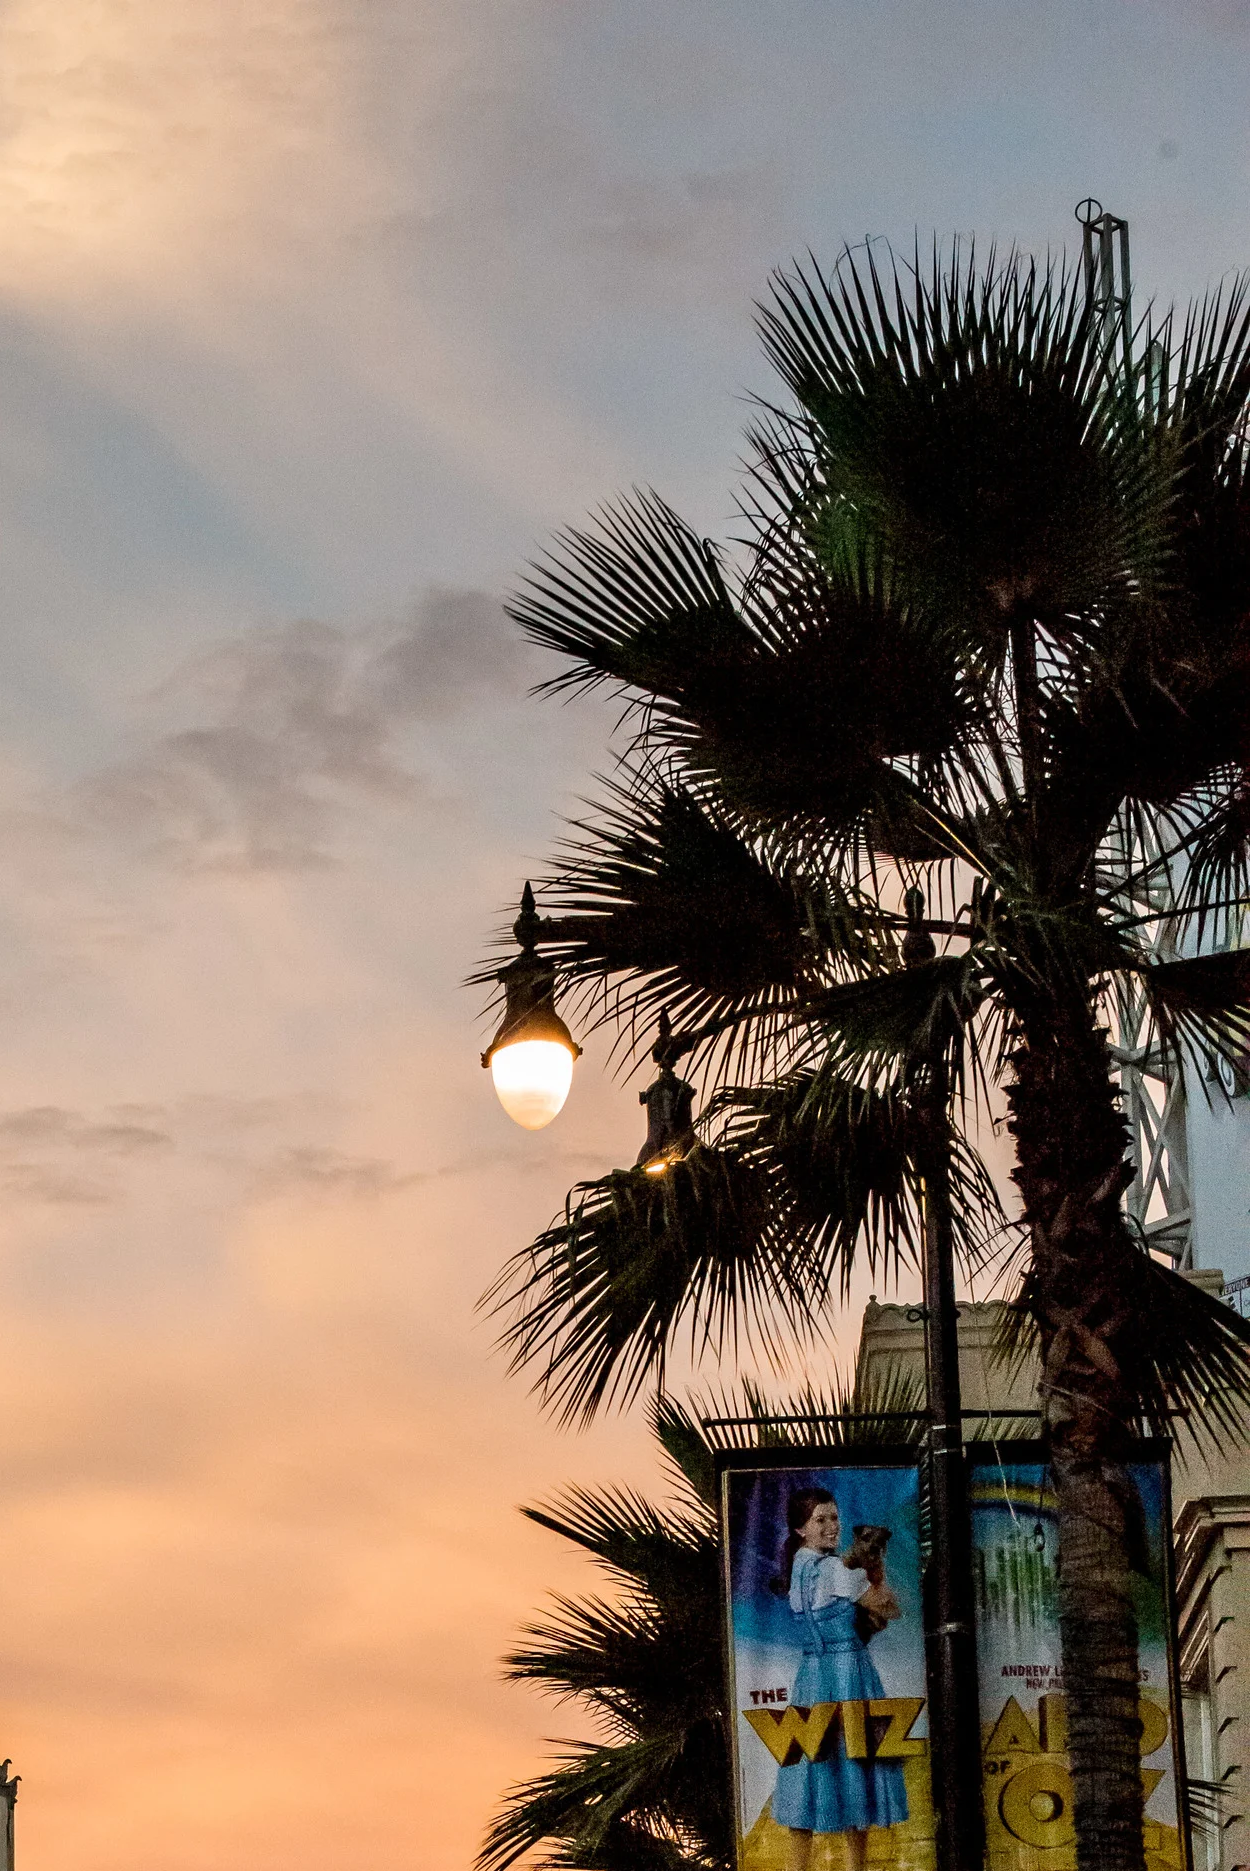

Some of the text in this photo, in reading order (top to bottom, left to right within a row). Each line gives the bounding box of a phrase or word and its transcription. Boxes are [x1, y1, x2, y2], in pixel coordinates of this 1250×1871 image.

[1000, 1665, 1050, 1678] ANDREW
[750, 1688, 787, 1704] THE
[742, 1698, 928, 1768] WIZ
[983, 1762, 1011, 1775] OF
